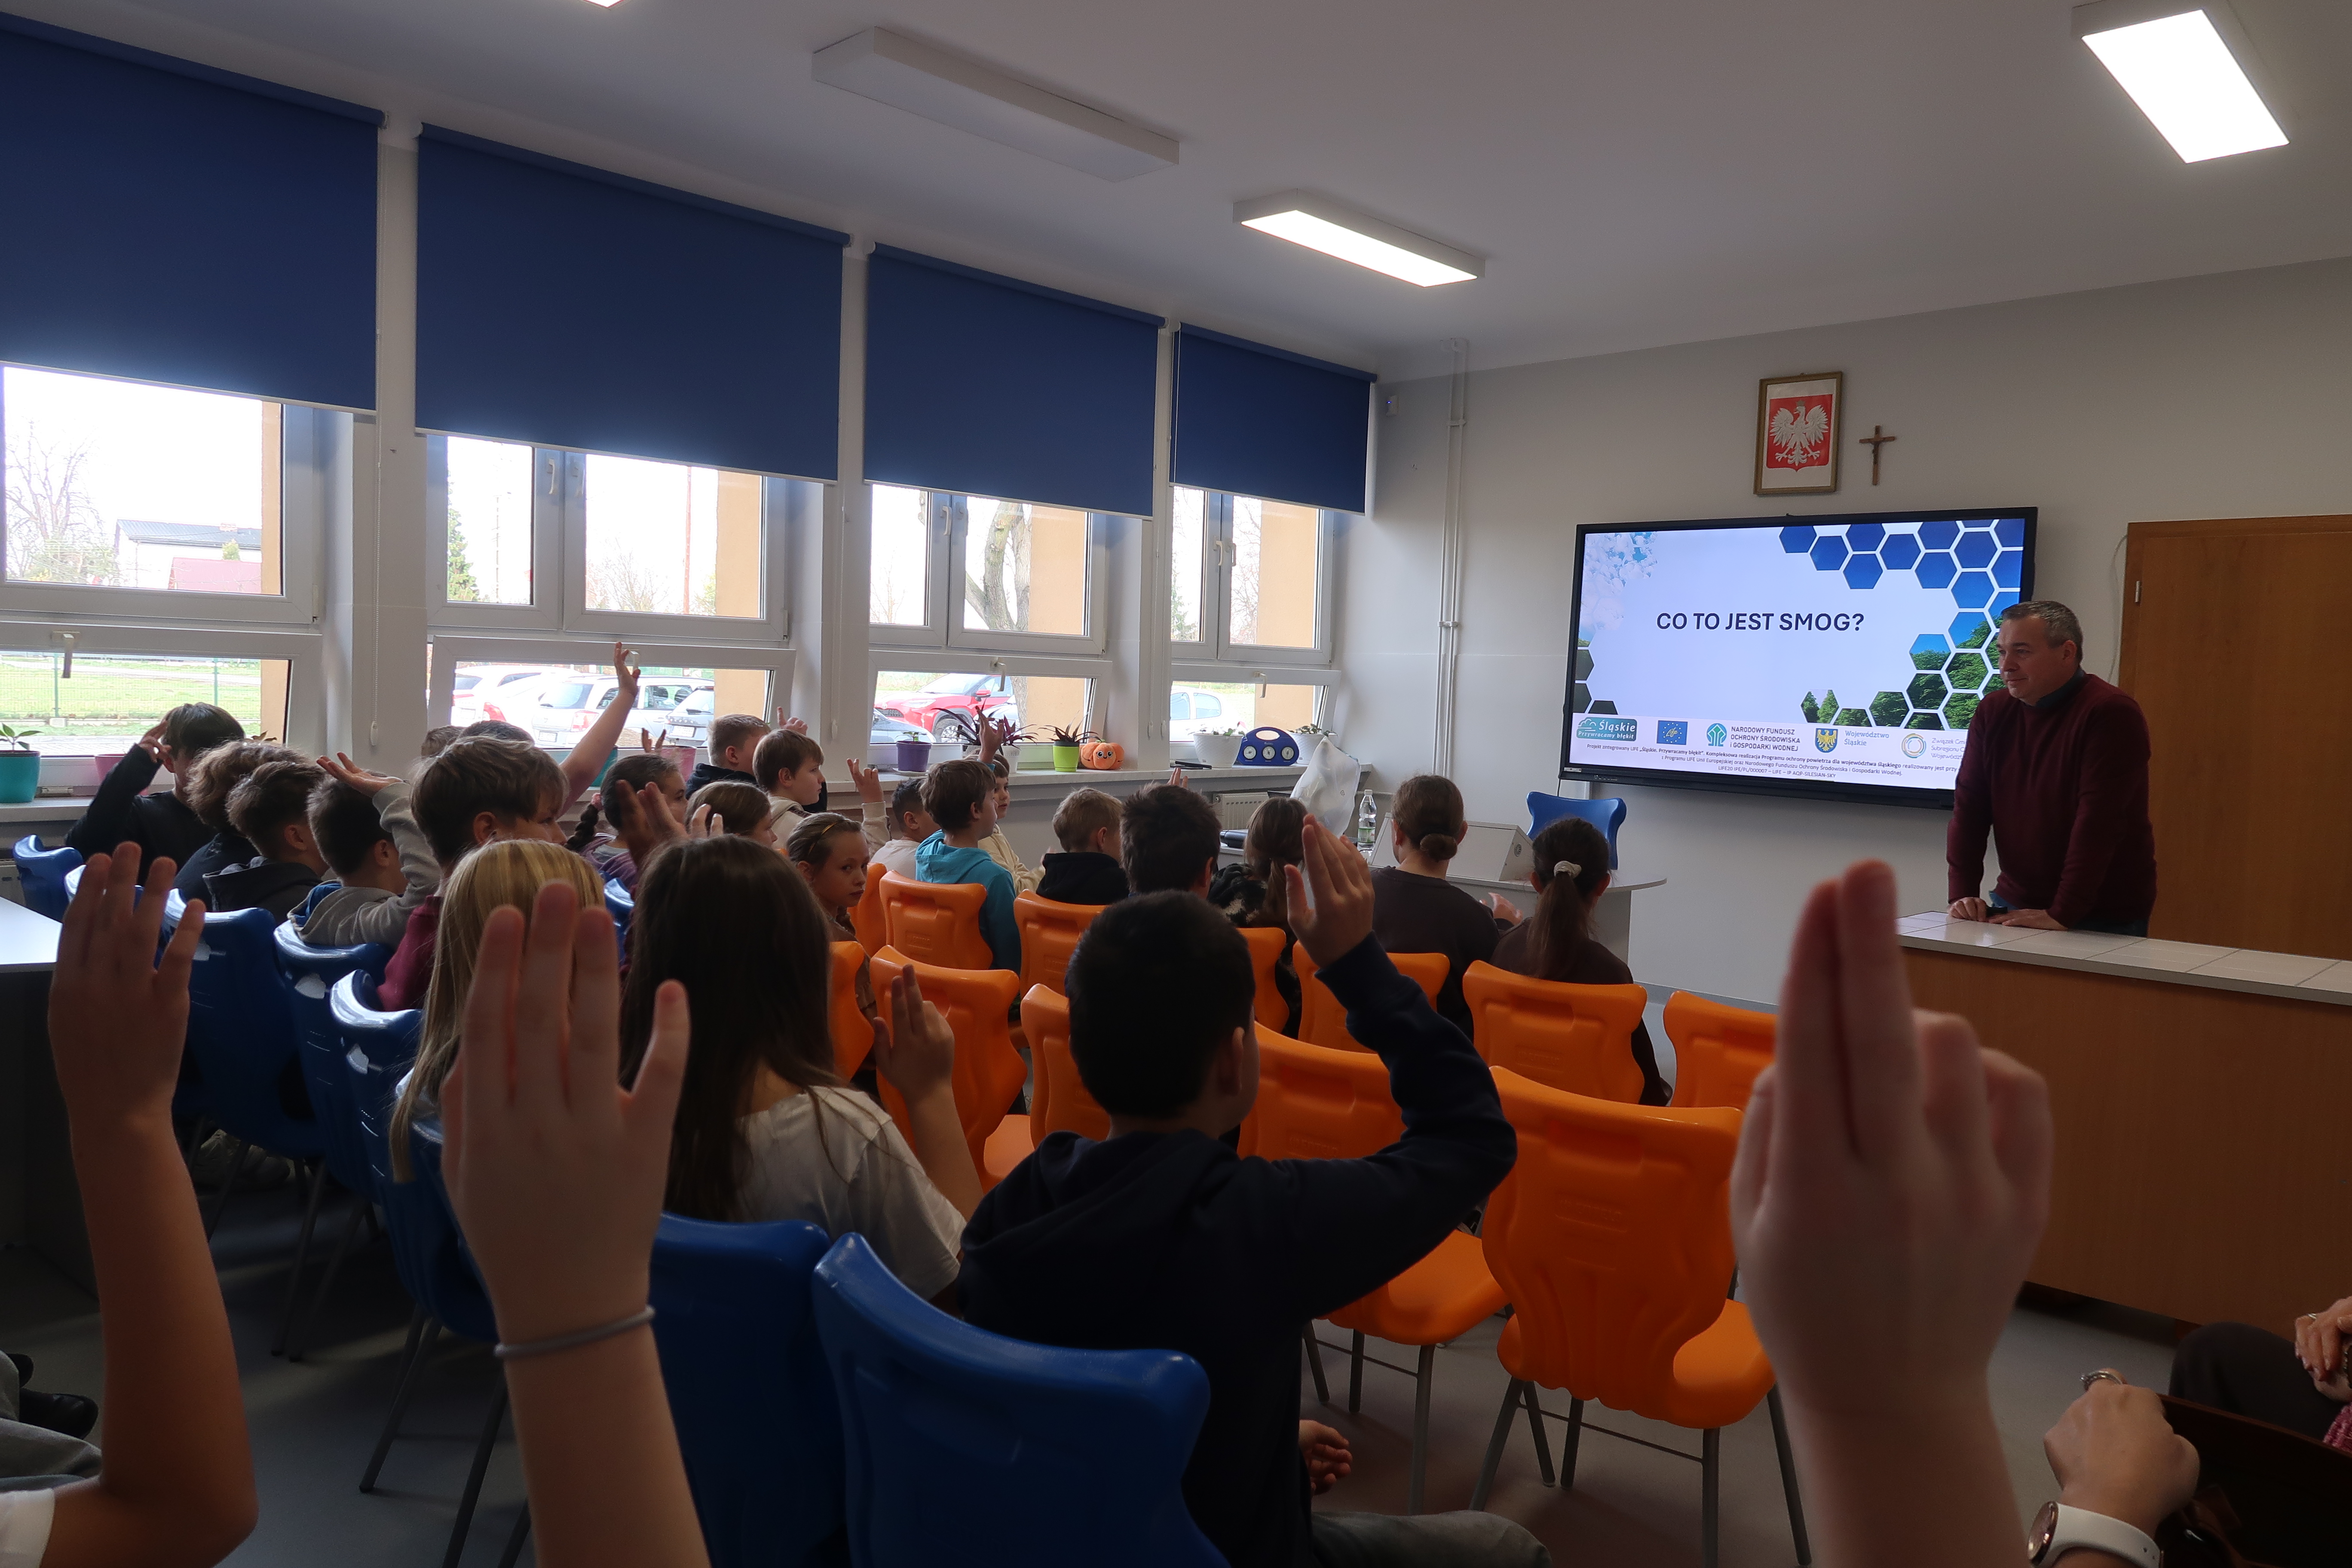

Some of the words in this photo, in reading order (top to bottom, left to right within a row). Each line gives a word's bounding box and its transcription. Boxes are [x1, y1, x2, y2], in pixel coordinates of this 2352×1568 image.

[1657, 612, 1687, 629] CO
[1693, 612, 1720, 630] TO
[1724, 612, 1774, 630] JEST
[1779, 613, 1864, 631] SMOG?
[1599, 719, 1635, 732] Śląskie
[1578, 731, 1615, 739] Przywracamy
[1760, 734, 1801, 743] ŚRODOWISKA
[1844, 738, 1867, 746] Śląskie
